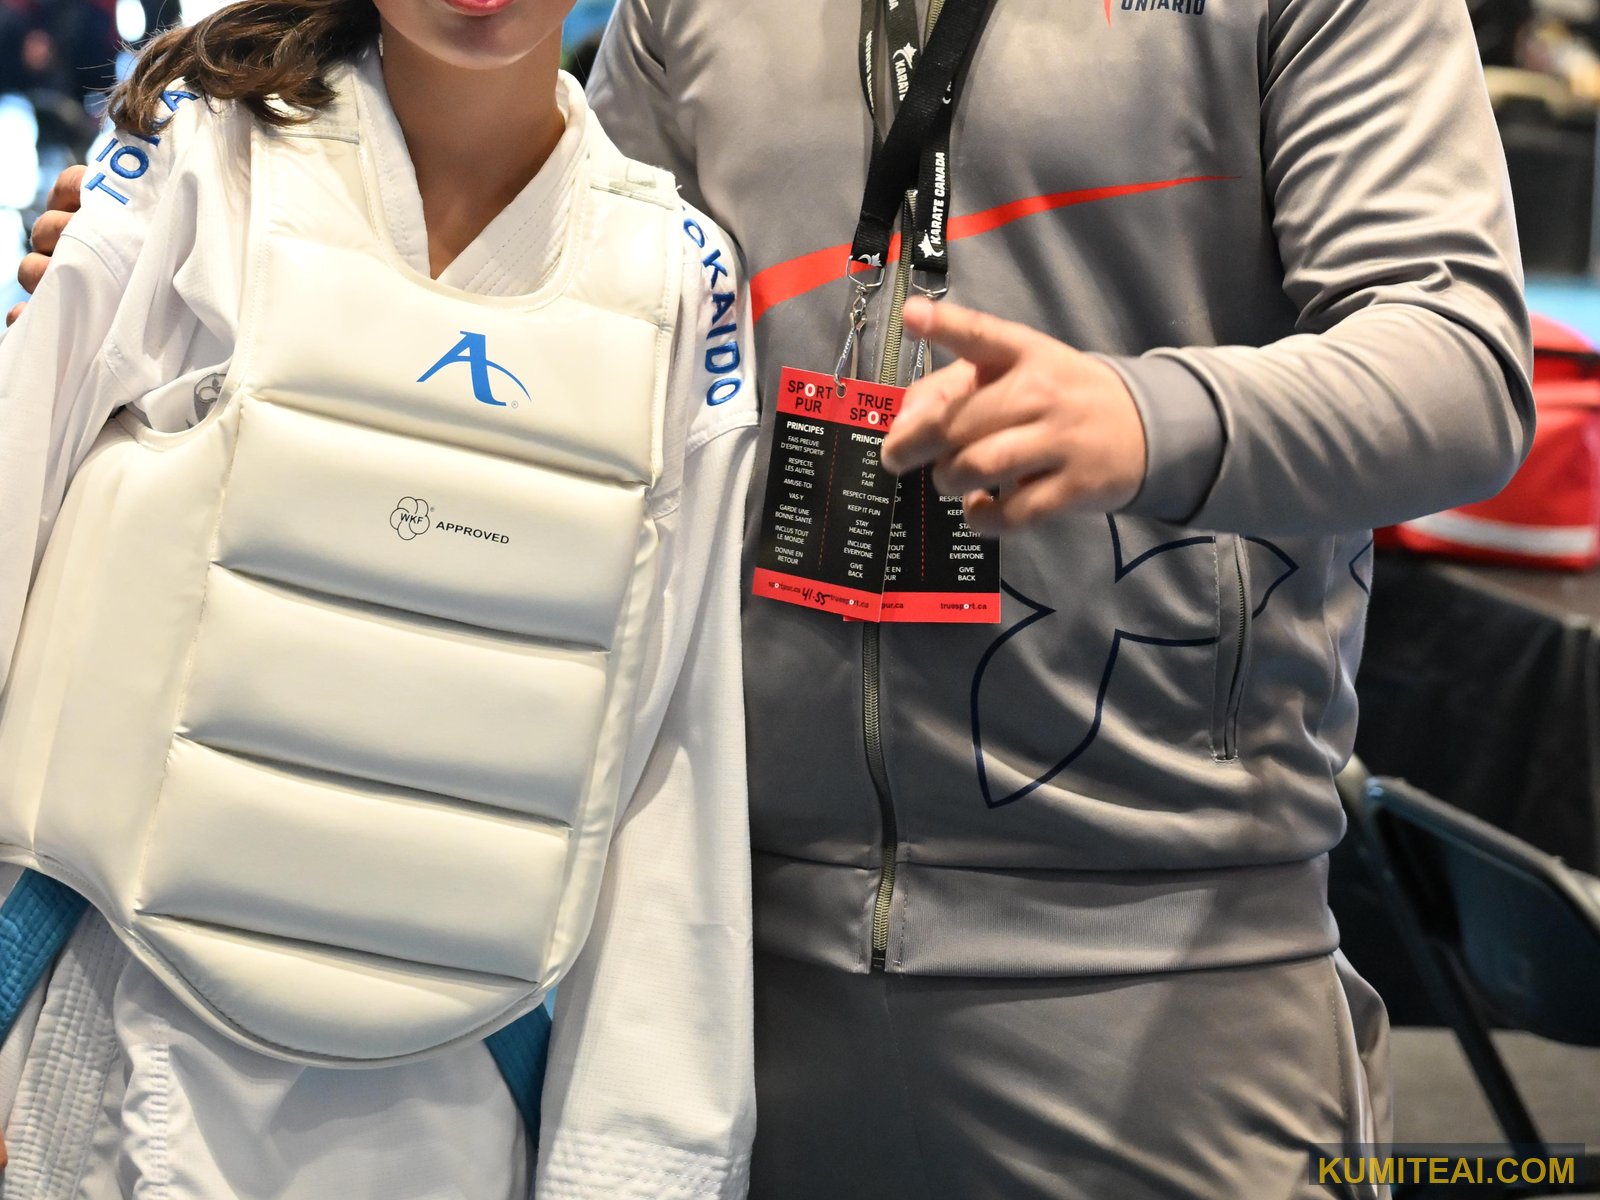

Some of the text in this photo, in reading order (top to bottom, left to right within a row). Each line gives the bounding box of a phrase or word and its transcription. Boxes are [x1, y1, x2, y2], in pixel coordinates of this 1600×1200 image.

[930, 152, 945, 244] KARATE CANADA
[682, 205, 742, 406] OKAIDO
[788, 380, 833, 399] SPORT
[795, 398, 822, 413] PUR
[858, 393, 893, 411] TRUE
[787, 421, 824, 435] PRINCIPES
[788, 457, 813, 467] RESPECTE
[795, 467, 815, 476] AUTRES
[862, 471, 876, 479] PLAY
[842, 490, 866, 499] RESPECT
[867, 494, 890, 504] OTHERS
[798, 508, 810, 516] UNE
[848, 504, 861, 512] KEEP
[869, 508, 881, 516] FUN
[400, 513, 423, 524] WKF
[436, 521, 510, 545] APPROVED
[795, 528, 809, 537] TOUT
[848, 526, 874, 536] HEALTHY
[847, 540, 872, 550] INCLUDE
[795, 550, 803, 558] EN
[843, 547, 874, 559] EVERYONE
[849, 562, 863, 570] GIVE
[847, 570, 863, 579] BACK
